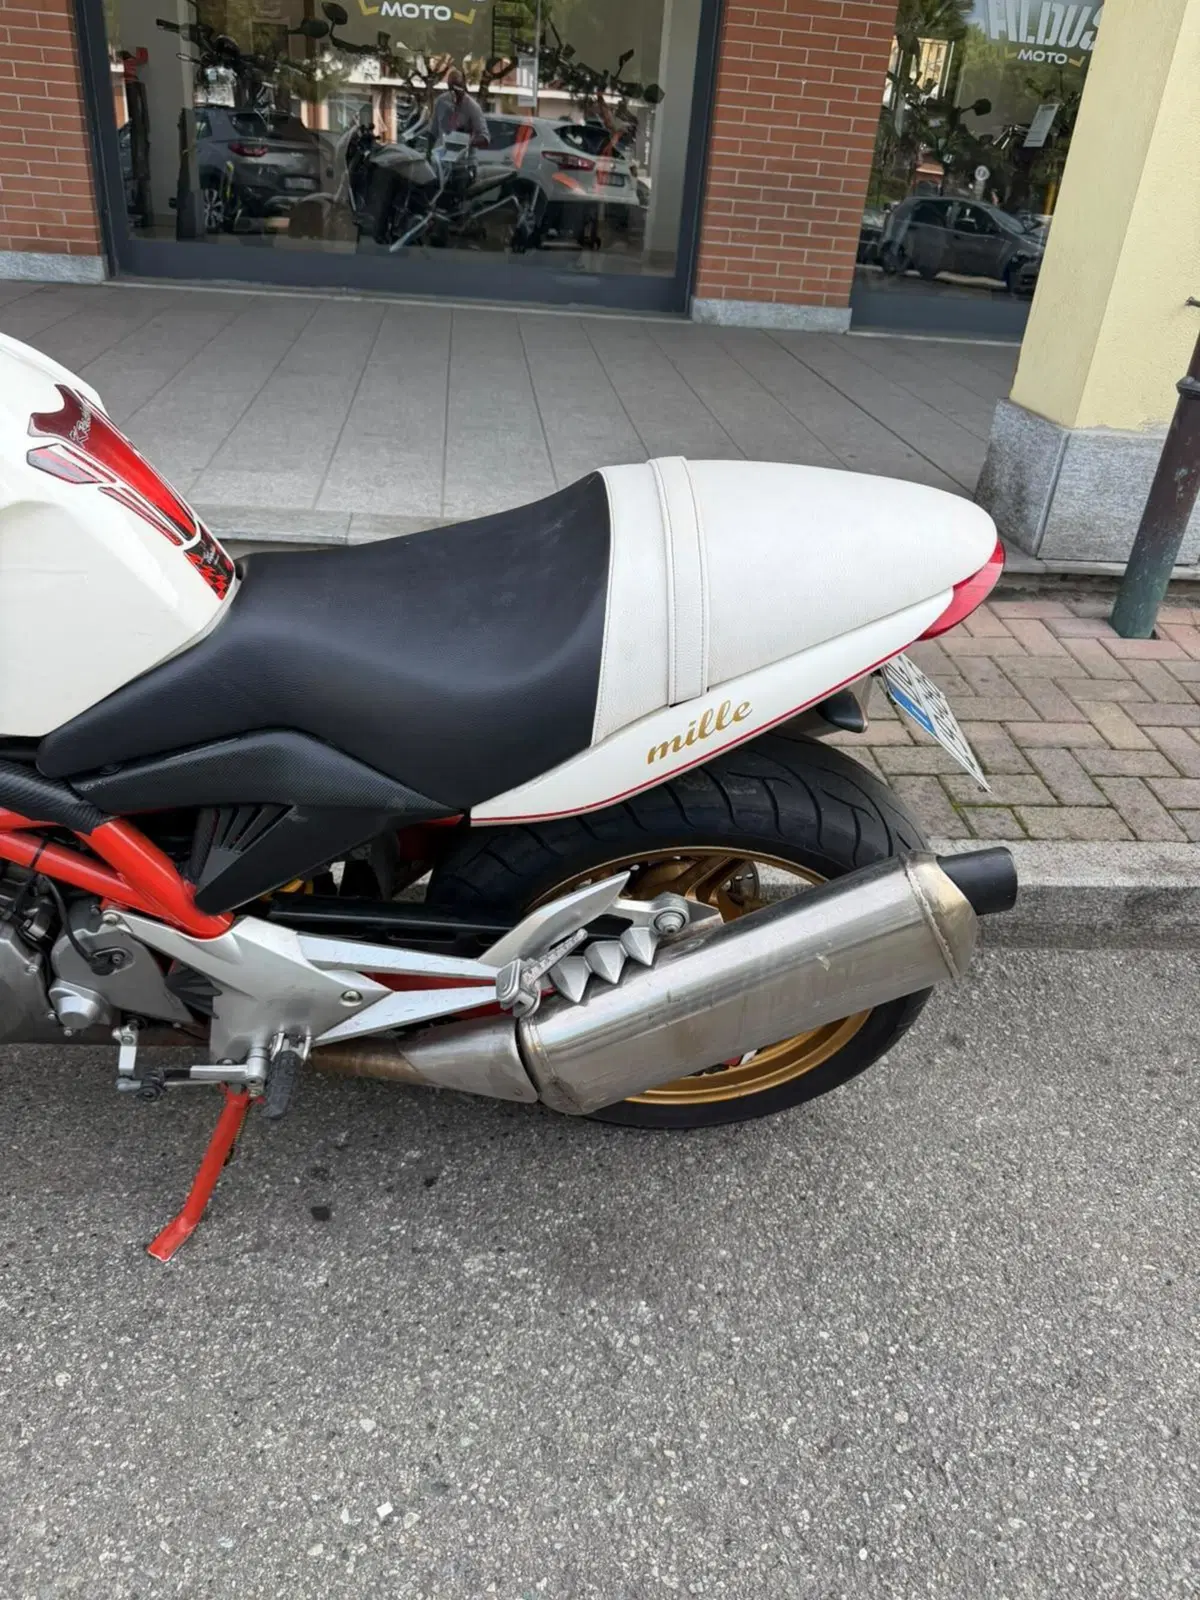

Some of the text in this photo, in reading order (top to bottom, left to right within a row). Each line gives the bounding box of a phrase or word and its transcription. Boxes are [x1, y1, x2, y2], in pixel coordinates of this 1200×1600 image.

[381, 1, 452, 21] MOTO
[1017, 49, 1068, 65] MOTO
[647, 700, 753, 765] mille
